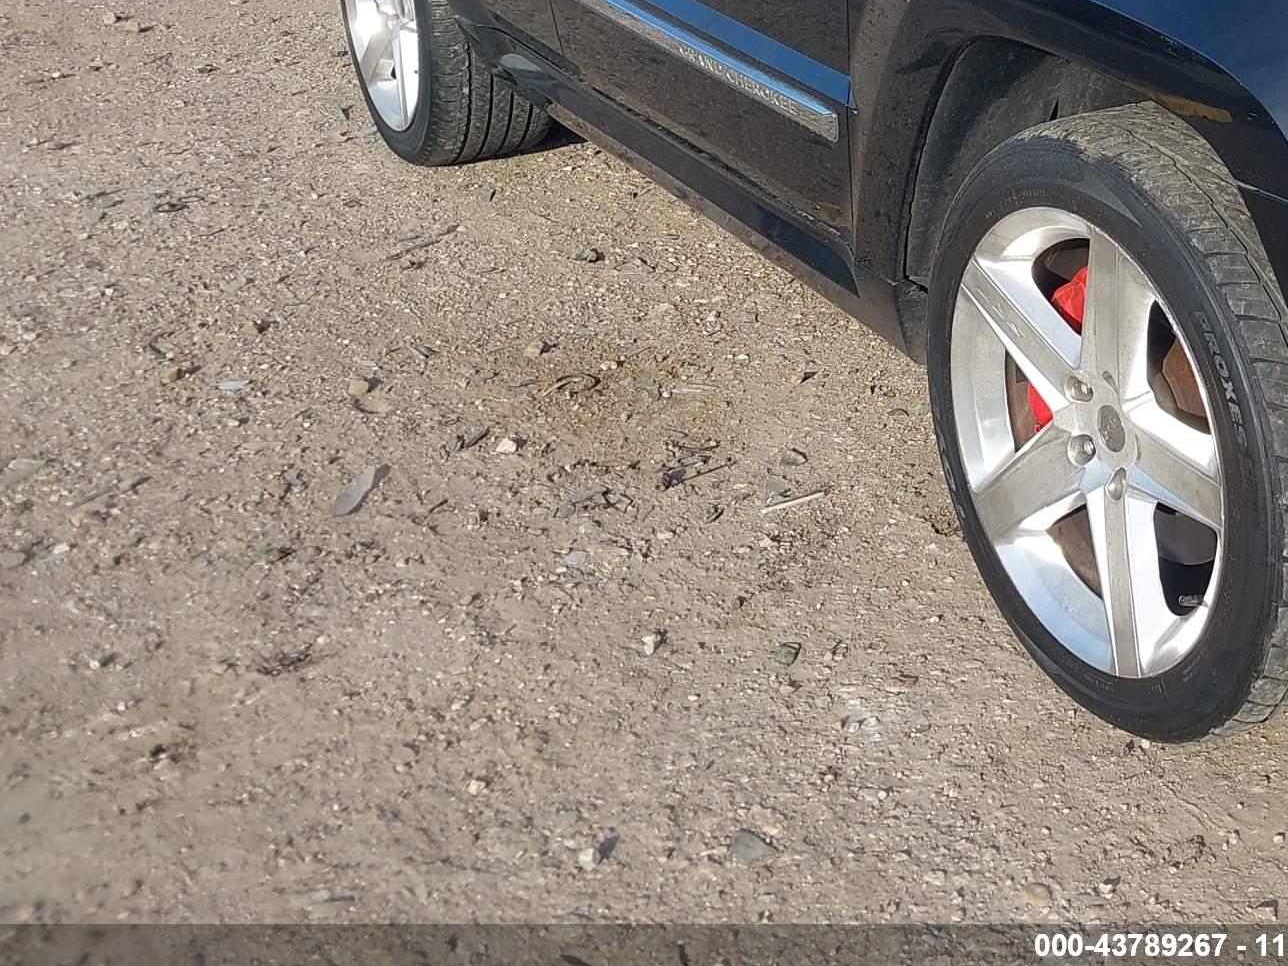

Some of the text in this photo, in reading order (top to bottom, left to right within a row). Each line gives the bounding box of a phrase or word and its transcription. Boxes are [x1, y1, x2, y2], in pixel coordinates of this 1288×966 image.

[678, 46, 799, 115] GRAND CHEROKEE
[1192, 310, 1248, 450] PROXES
